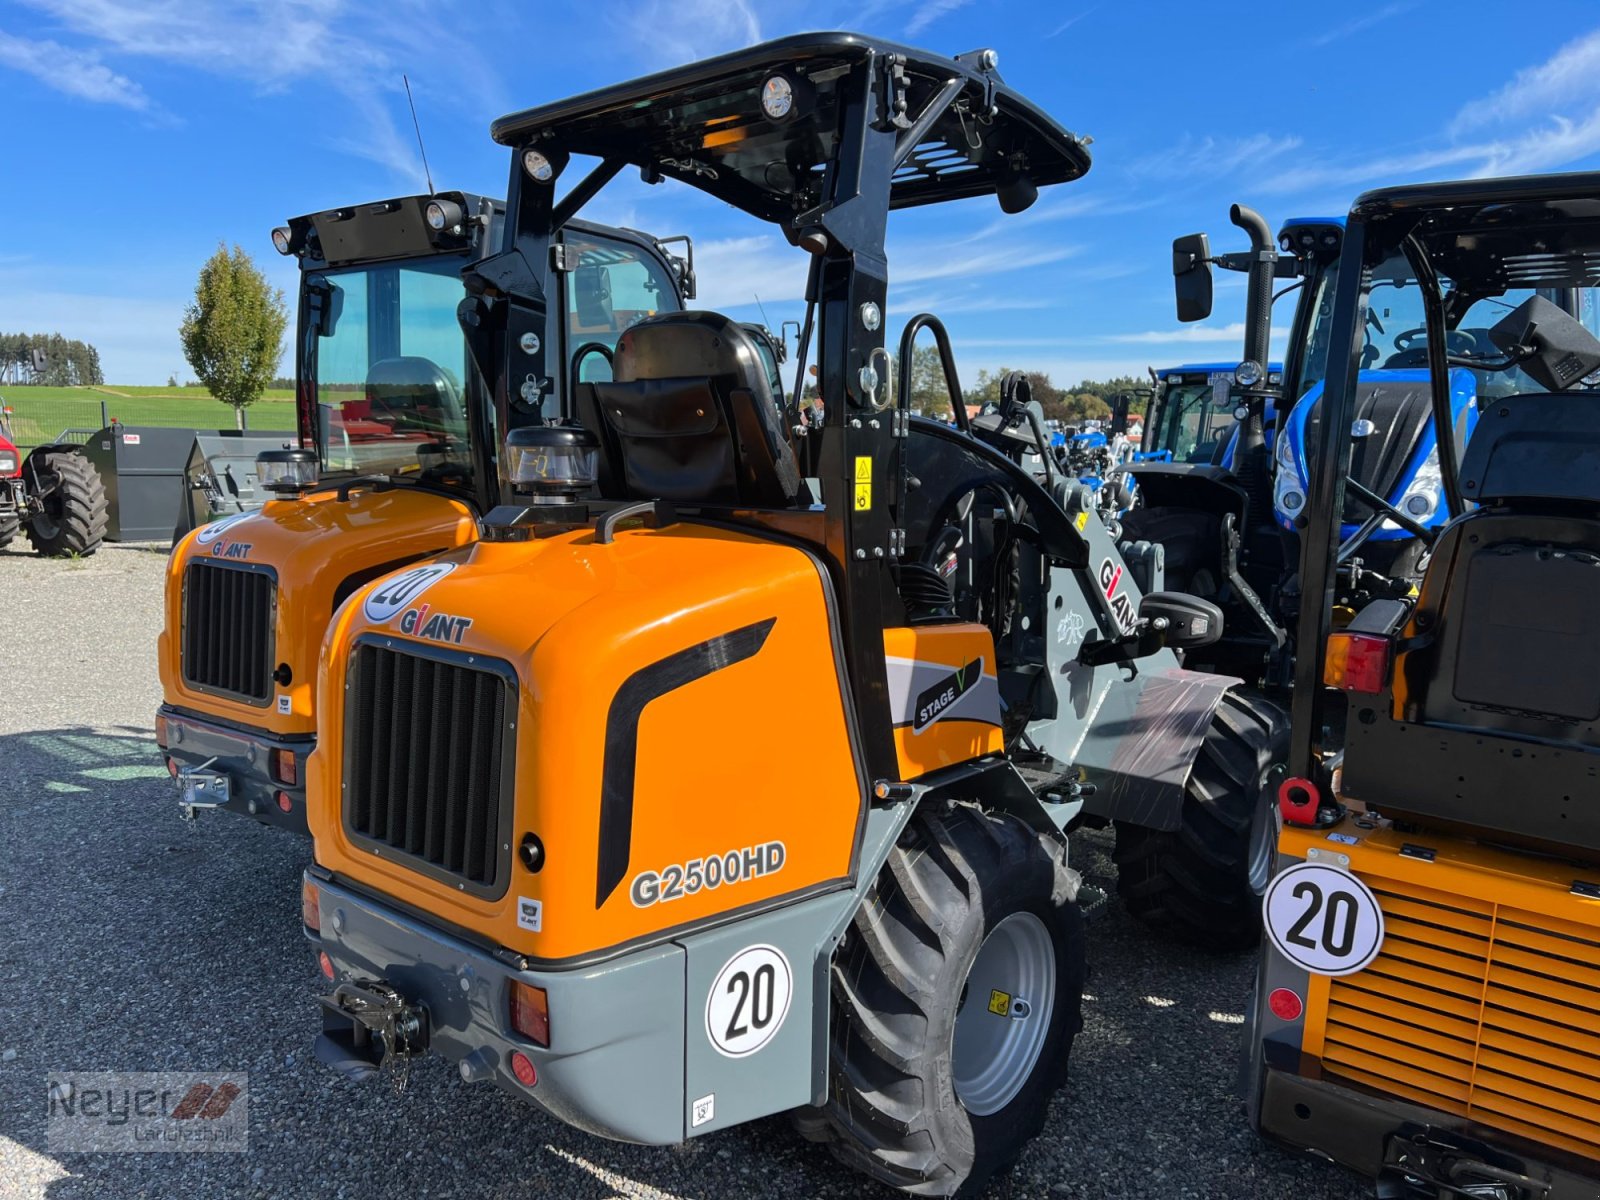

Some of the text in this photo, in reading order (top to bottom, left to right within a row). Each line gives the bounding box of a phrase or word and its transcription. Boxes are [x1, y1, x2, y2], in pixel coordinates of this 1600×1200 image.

[370, 568, 443, 606] 20
[920, 687, 955, 722] STAGE
[630, 841, 786, 908] G2500HD
[1285, 881, 1359, 957] 20
[725, 963, 775, 1041] 20
